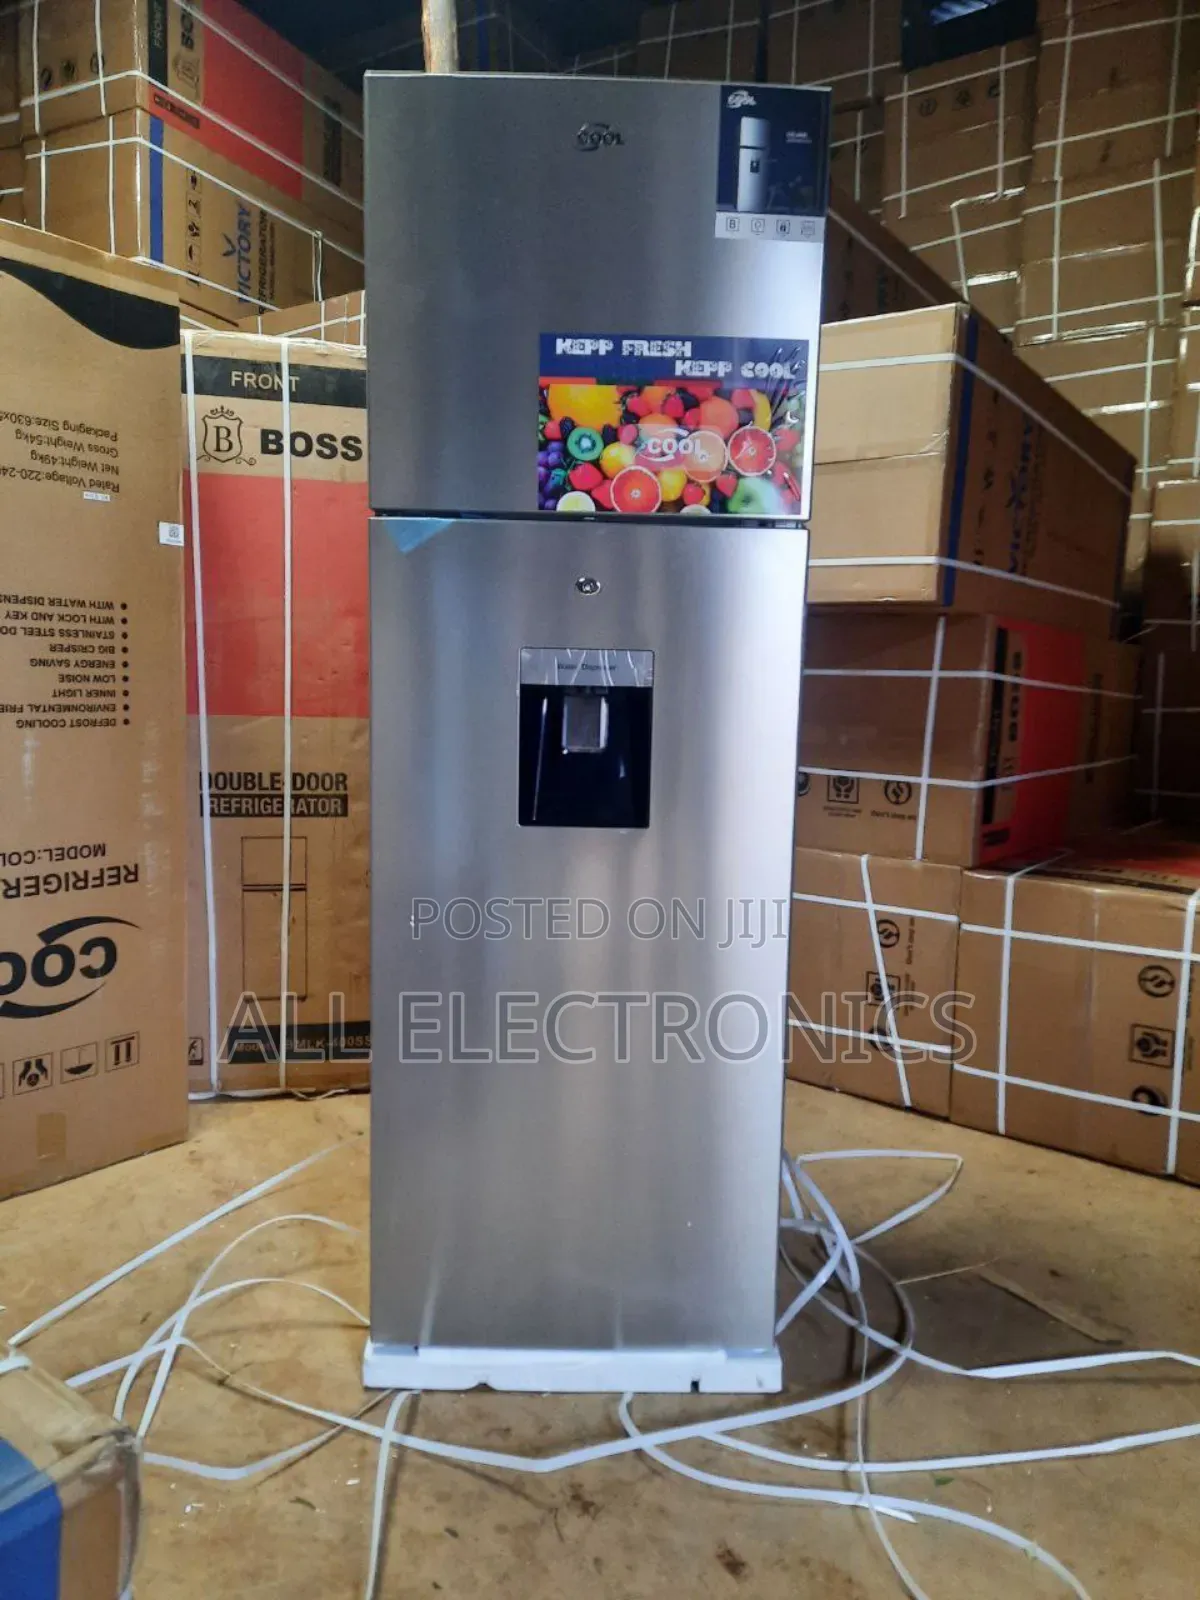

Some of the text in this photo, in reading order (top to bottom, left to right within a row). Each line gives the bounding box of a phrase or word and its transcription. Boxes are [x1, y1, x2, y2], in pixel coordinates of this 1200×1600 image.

[556, 338, 692, 358] KEPP FRESH
[674, 360, 797, 380] KEPP COOL
[231, 371, 300, 392] FRONT
[63, 420, 118, 442] Packaging
[15, 429, 119, 459] Gross Weight:54kg
[213, 425, 363, 462] B BOSS
[30, 450, 119, 476] Net Weight:49kg
[0, 466, 120, 493] Rated Voltage:220-24
[48, 598, 87, 608] WATER
[89, 601, 114, 610] WITH
[4, 610, 115, 625] WITH LOCK AND KEY
[20, 626, 55, 637] STEEL
[59, 628, 115, 639] STAINLESS
[49, 643, 115, 654] BIG CRISPER
[29, 658, 115, 669] ENERGY SAVING
[581, 663, 617, 672] Dispeer
[58, 673, 115, 683] LOW NOISE
[51, 688, 116, 698] INNER LIGHT
[28, 703, 116, 713] ENVIRONMENTAL
[16, 719, 116, 729] DEFROST COOLING
[199, 772, 348, 791] DOUBLEDOOR
[208, 796, 342, 814] REFRIGEATOR
[0, 843, 106, 867] MODEL:COL
[2, 863, 140, 899] REFRIGER
